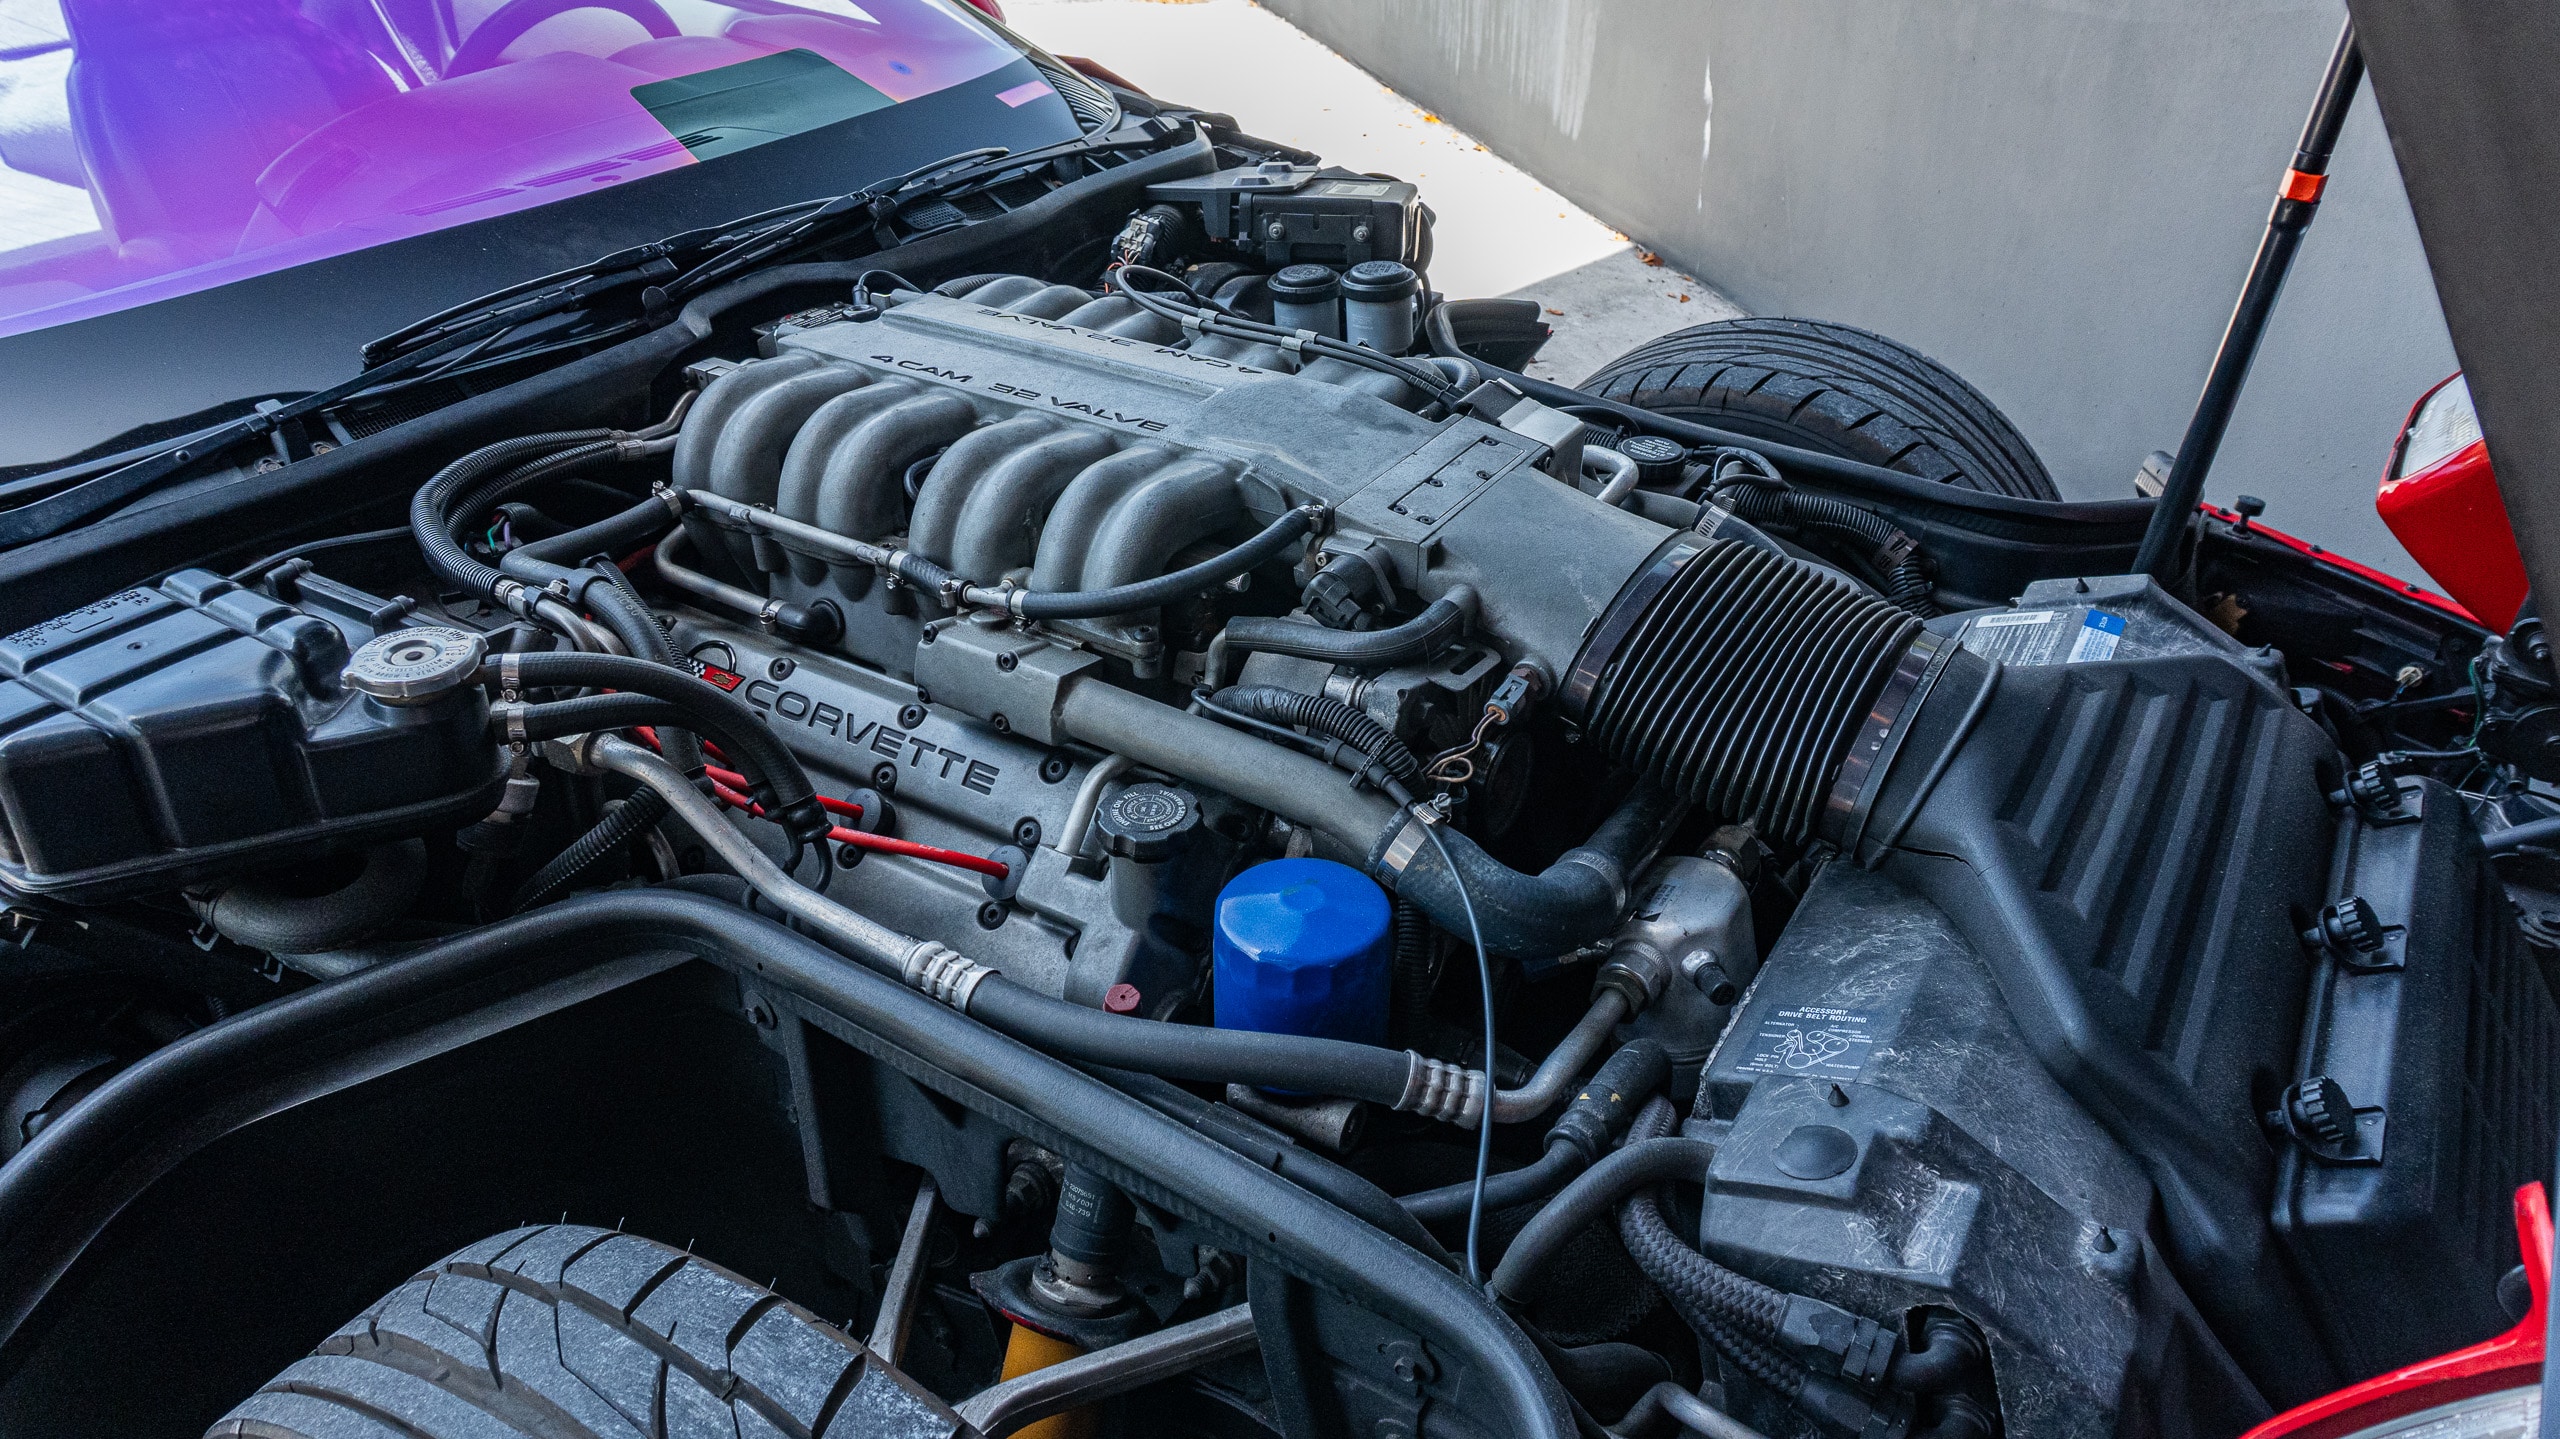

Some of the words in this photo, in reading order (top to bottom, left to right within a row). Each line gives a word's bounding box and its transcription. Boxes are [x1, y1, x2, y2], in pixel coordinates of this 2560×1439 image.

[976, 307, 1078, 336] VALVE
[1088, 333, 1138, 348] 32
[1154, 347, 1232, 369] CAM
[869, 354, 895, 365] 4
[897, 358, 974, 384] CAM
[987, 381, 1042, 402] 32
[1050, 395, 1169, 433] VALVE
[744, 678, 1001, 797] CORVETTE
[1122, 791, 1140, 800] FILL
[1799, 1006, 1848, 1015] ACCESSORY
[1829, 1015, 1867, 1023] ROUTING
